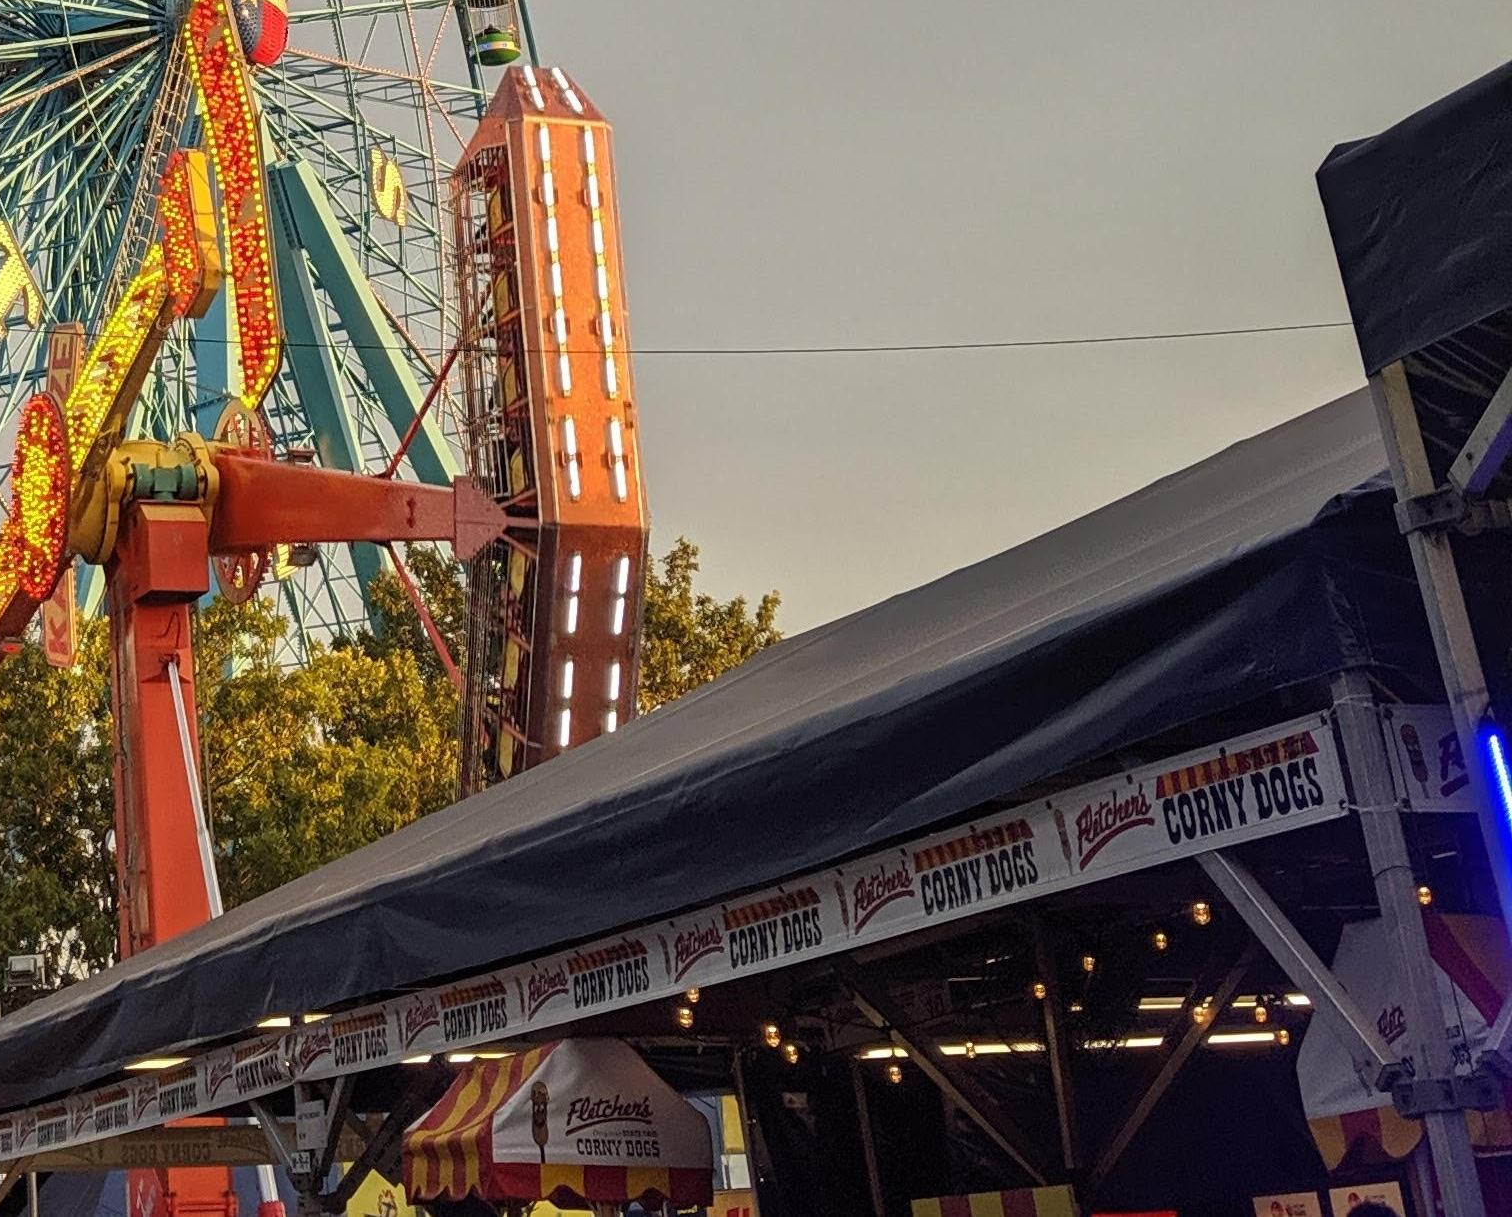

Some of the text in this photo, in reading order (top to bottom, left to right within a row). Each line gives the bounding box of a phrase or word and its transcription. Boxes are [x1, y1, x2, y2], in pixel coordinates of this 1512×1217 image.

[1162, 774, 1248, 846] CORNY
[1251, 756, 1325, 822] DOGS
[920, 857, 983, 916] CORNY
[985, 841, 1039, 896] DOGS
[729, 918, 779, 970] CORNY
[780, 906, 823, 953] DOGS
[573, 966, 615, 1009] CORNY
[616, 956, 650, 998] DOGS
[443, 1003, 479, 1042] CORNY
[480, 997, 509, 1033] DOGS
[566, 1095, 654, 1130] Fletcher's
[576, 1138, 661, 1158] CORNY DOGS
